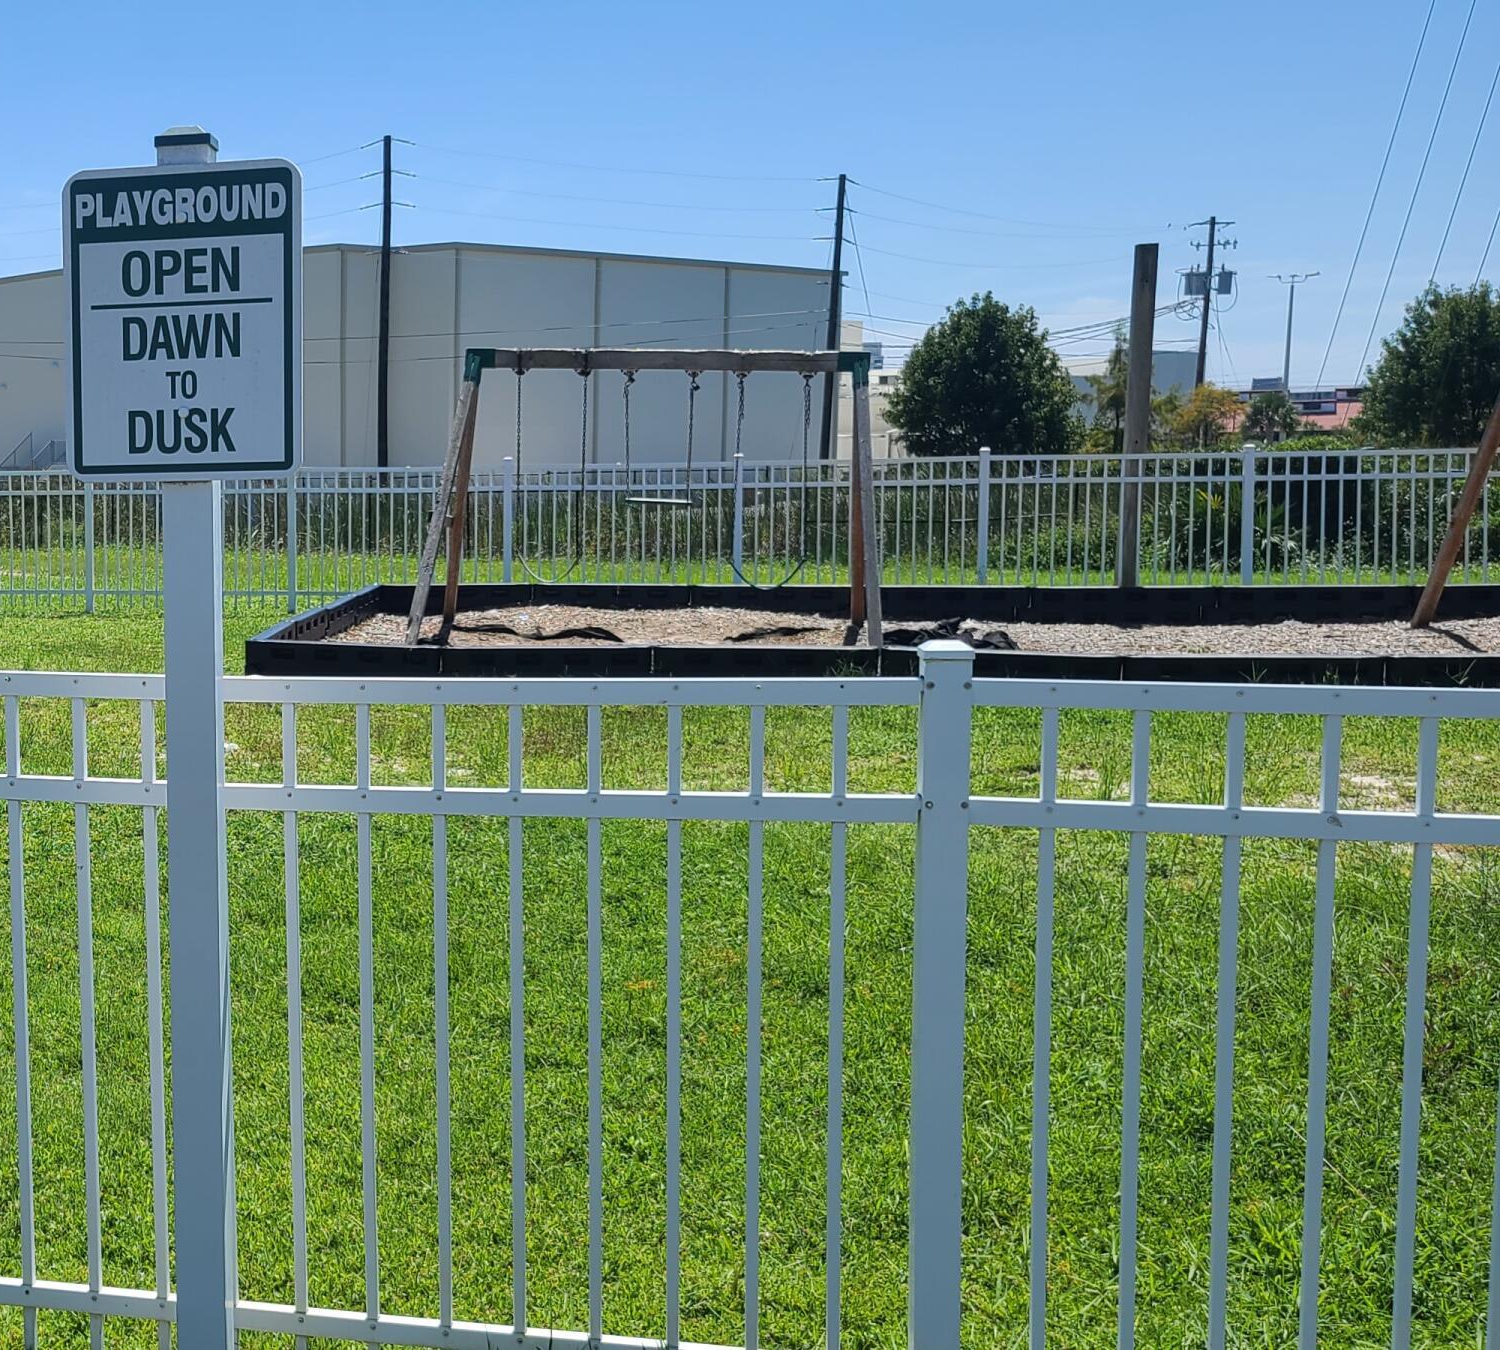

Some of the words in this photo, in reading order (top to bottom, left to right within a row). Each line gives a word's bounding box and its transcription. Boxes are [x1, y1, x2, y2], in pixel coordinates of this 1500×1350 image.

[76, 182, 287, 229] PLAYGROUND
[121, 246, 240, 297] OPEN
[122, 312, 241, 361] DAWN
[165, 370, 197, 399] TO
[128, 407, 237, 454] DUSK
